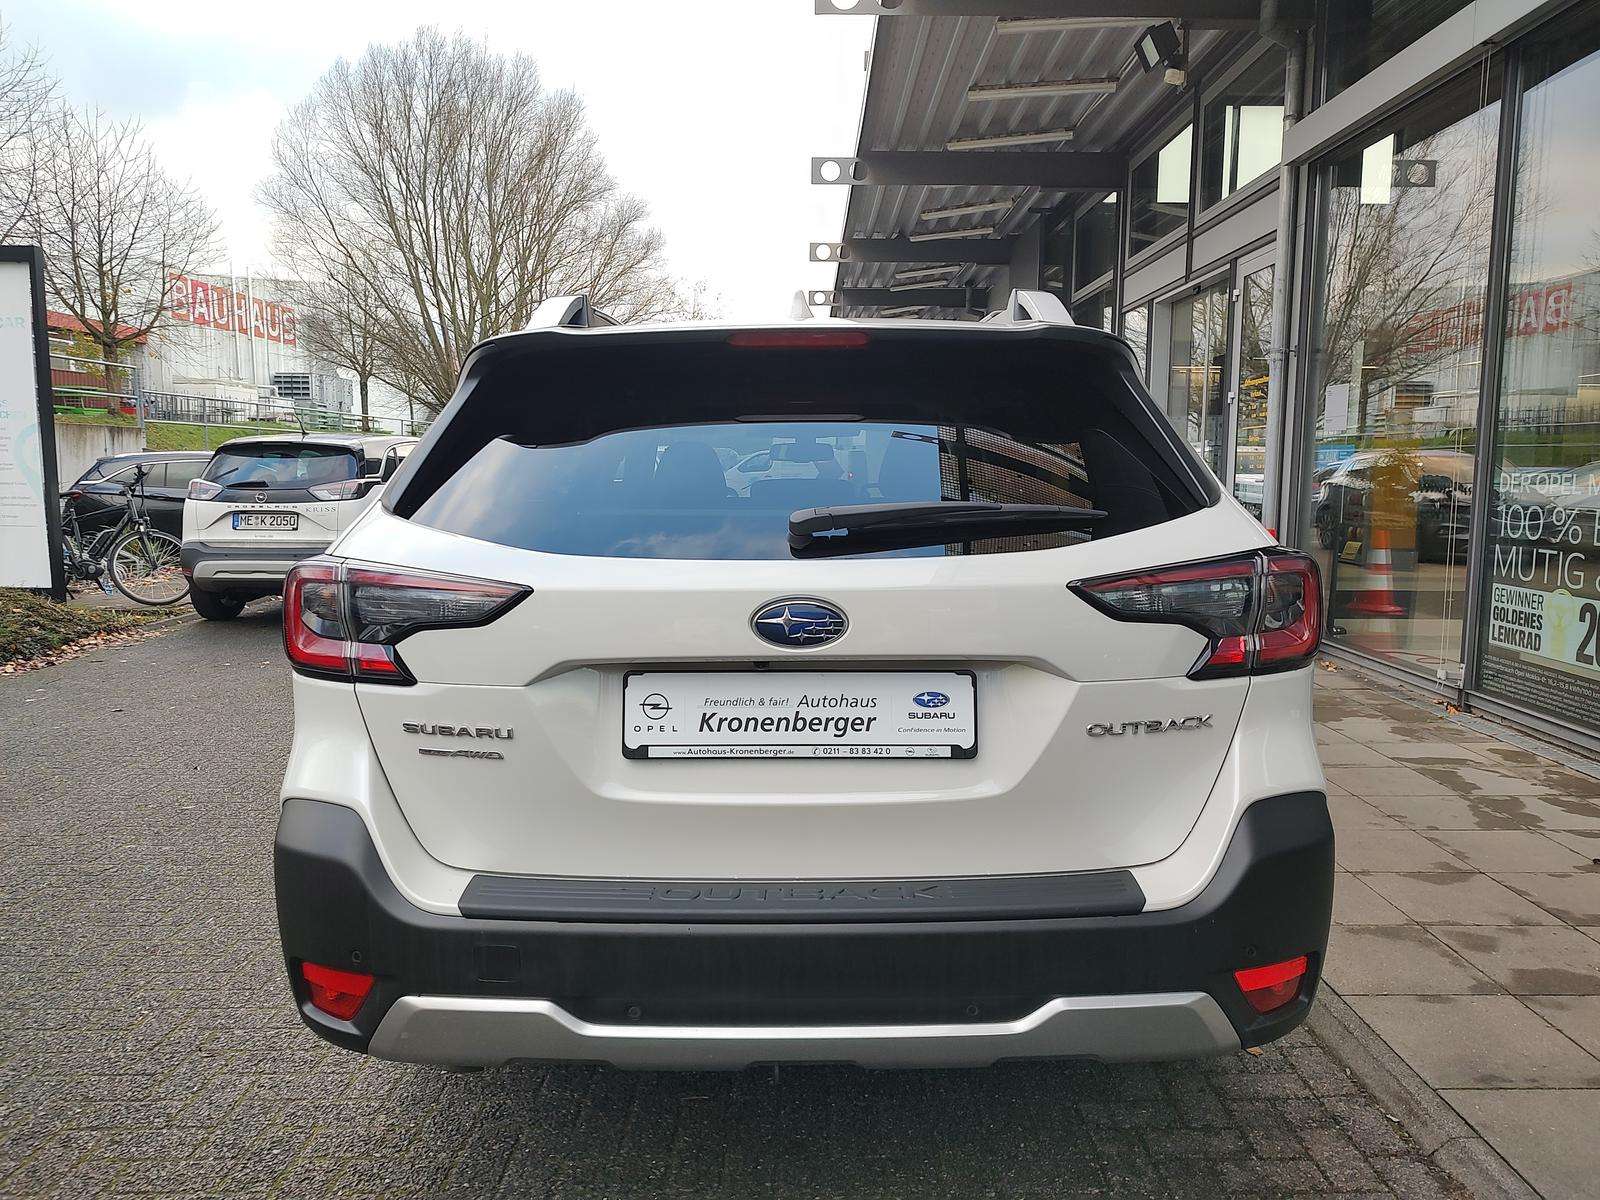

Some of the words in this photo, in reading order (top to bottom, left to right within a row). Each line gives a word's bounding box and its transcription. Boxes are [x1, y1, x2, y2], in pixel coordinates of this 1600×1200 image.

[170, 275, 296, 341] BAUHAUS
[1500, 472, 1530, 494] DER
[1537, 474, 1577, 495] OPEL
[240, 515, 253, 526] ME
[260, 515, 268, 527] K
[269, 515, 296, 527] 2050
[1497, 504, 1543, 540] 100
[1553, 507, 1582, 545] %
[1493, 543, 1586, 590] MUTIG
[1494, 587, 1544, 611] GEWINNER
[1493, 605, 1543, 631] GOLDENES
[1491, 623, 1541, 652] LENKRAD
[704, 697, 754, 707] Freundlich
[758, 698, 766, 707] &
[768, 697, 789, 708] fair!
[797, 694, 877, 708] Autohaus
[698, 711, 877, 737] Kronenberger
[908, 712, 956, 720] SUBARU
[1086, 714, 1213, 737] OUTBACK
[402, 722, 514, 740] SUBARU
[450, 750, 505, 760] AWD
[673, 748, 795, 756] www.Autohaus-Kronenberger.de
[822, 747, 840, 755] 0211
[849, 747, 859, 755] 83
[861, 747, 872, 755] 83
[873, 747, 883, 755] 42
[885, 747, 891, 755] 0
